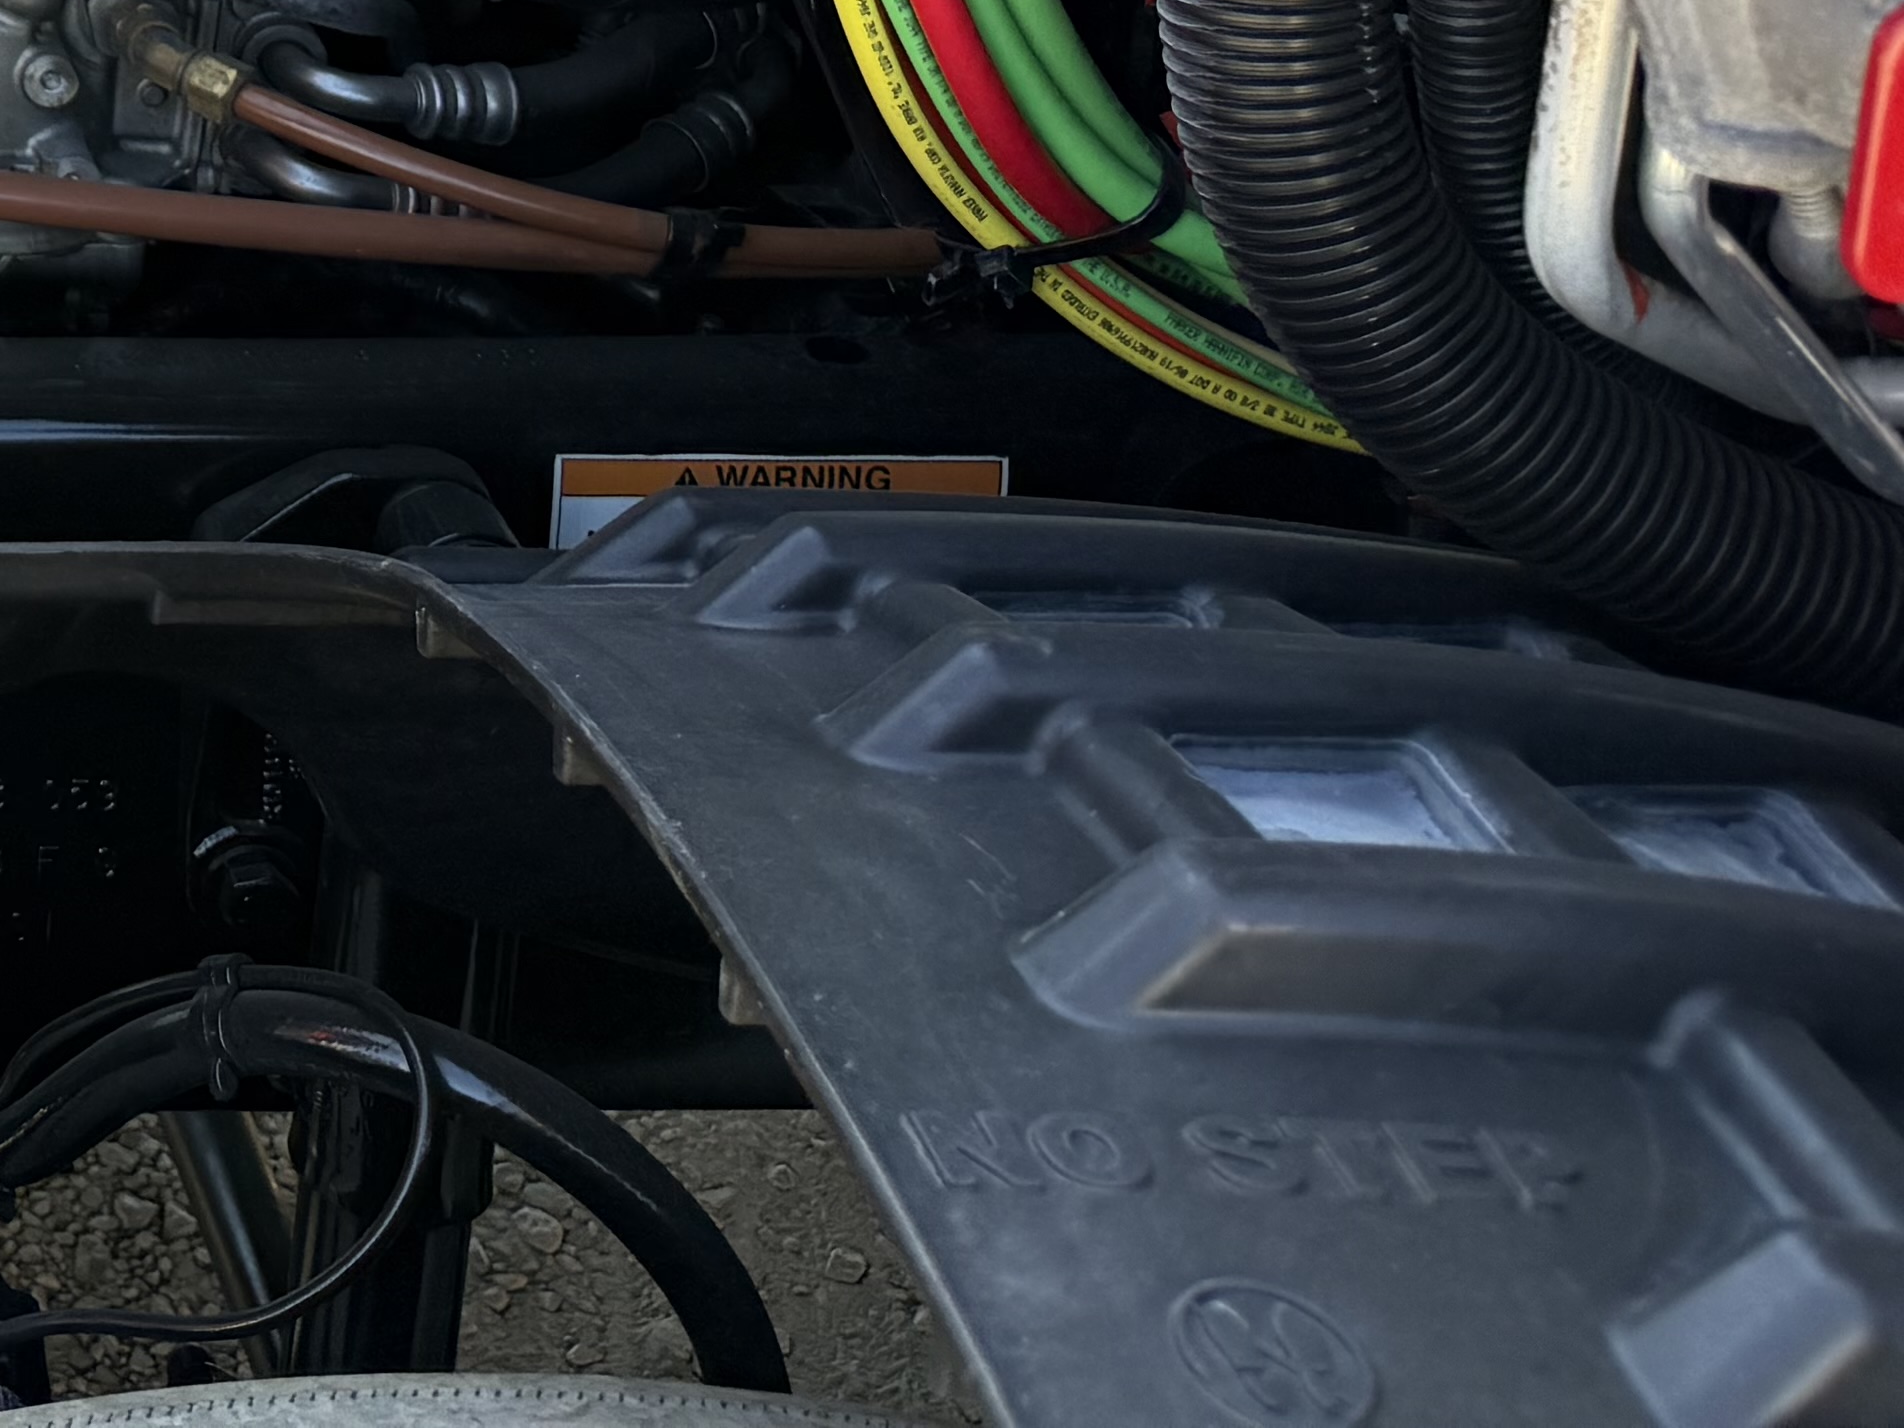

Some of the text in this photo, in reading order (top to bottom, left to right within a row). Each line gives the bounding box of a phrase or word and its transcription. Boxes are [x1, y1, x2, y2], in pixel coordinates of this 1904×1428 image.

[1060, 288, 1100, 323] EXTRUDED
[1188, 374, 1211, 391] DOT
[715, 464, 891, 490] WARNING
[899, 1110, 1584, 1212] NO STEP
